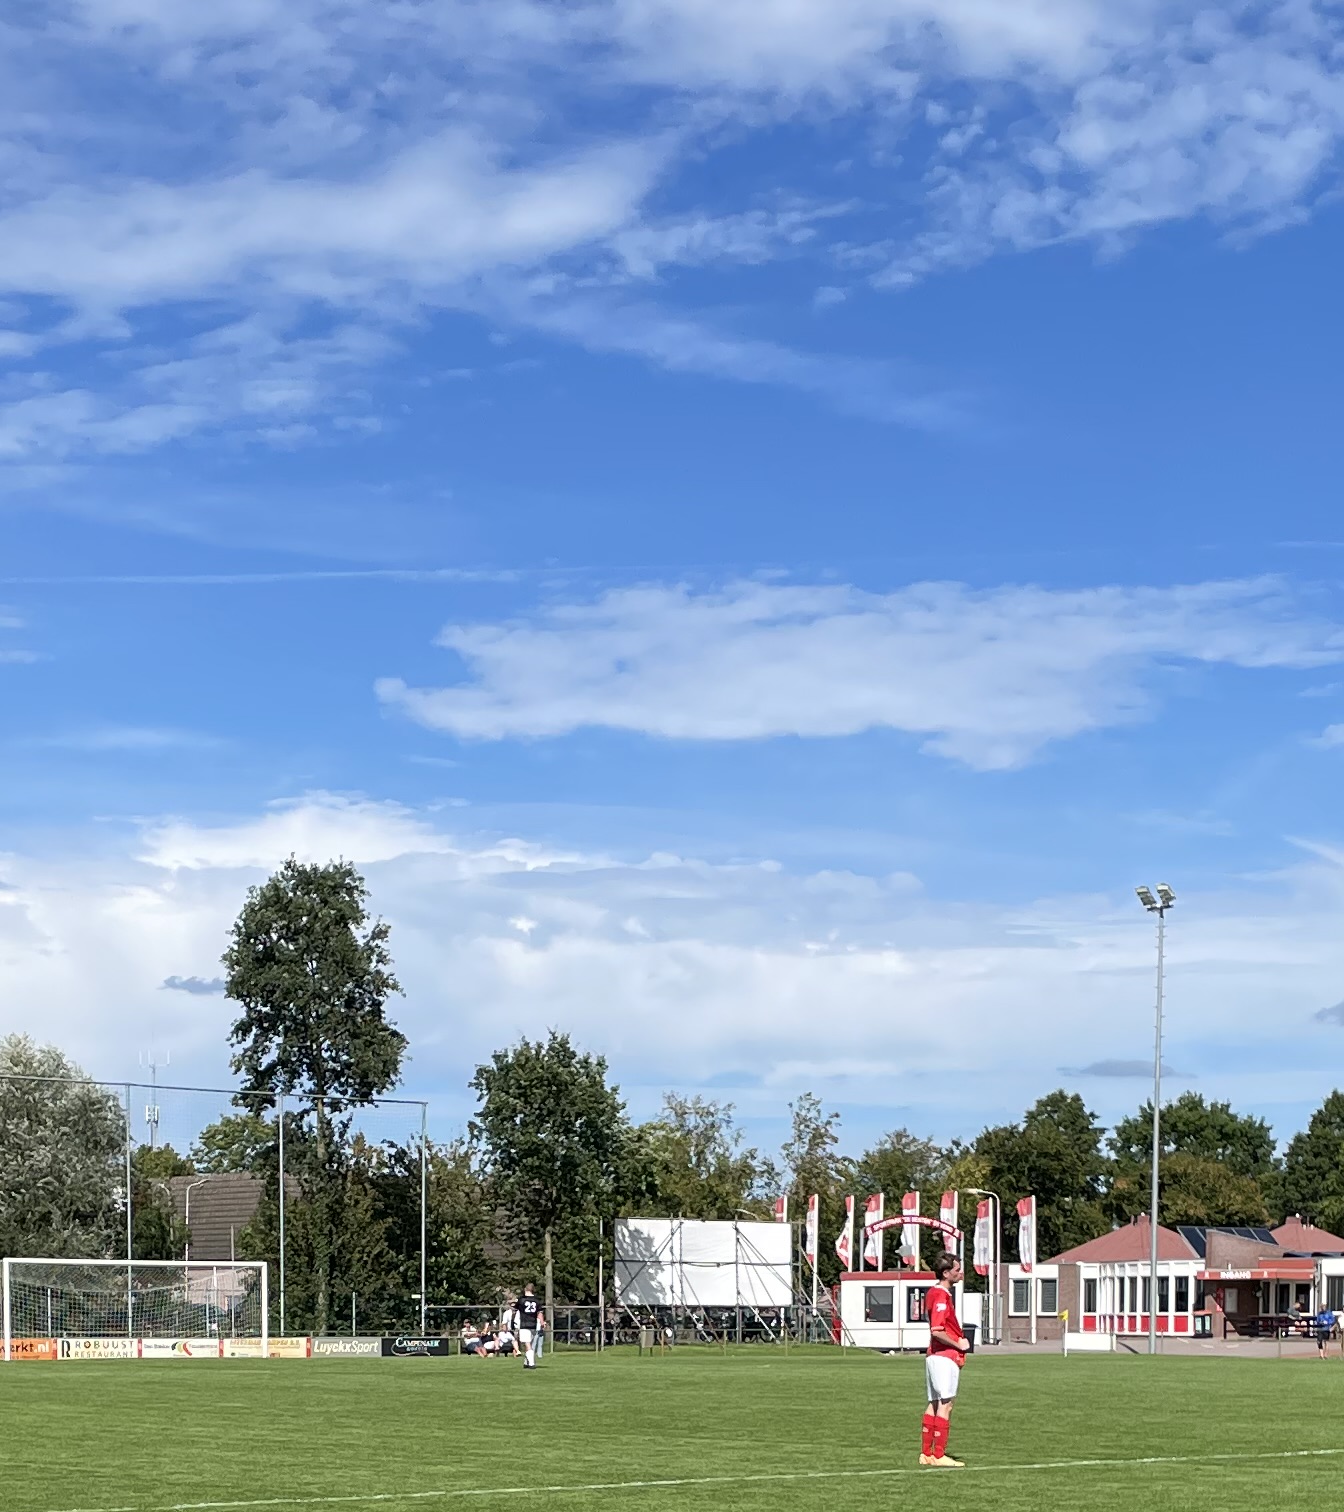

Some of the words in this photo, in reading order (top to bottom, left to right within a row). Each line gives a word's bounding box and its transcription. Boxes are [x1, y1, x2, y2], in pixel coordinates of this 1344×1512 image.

[524, 1301, 537, 1313] 23
[75, 1340, 134, 1349] ROBUUST
[74, 1350, 135, 1358] RESTAURANT
